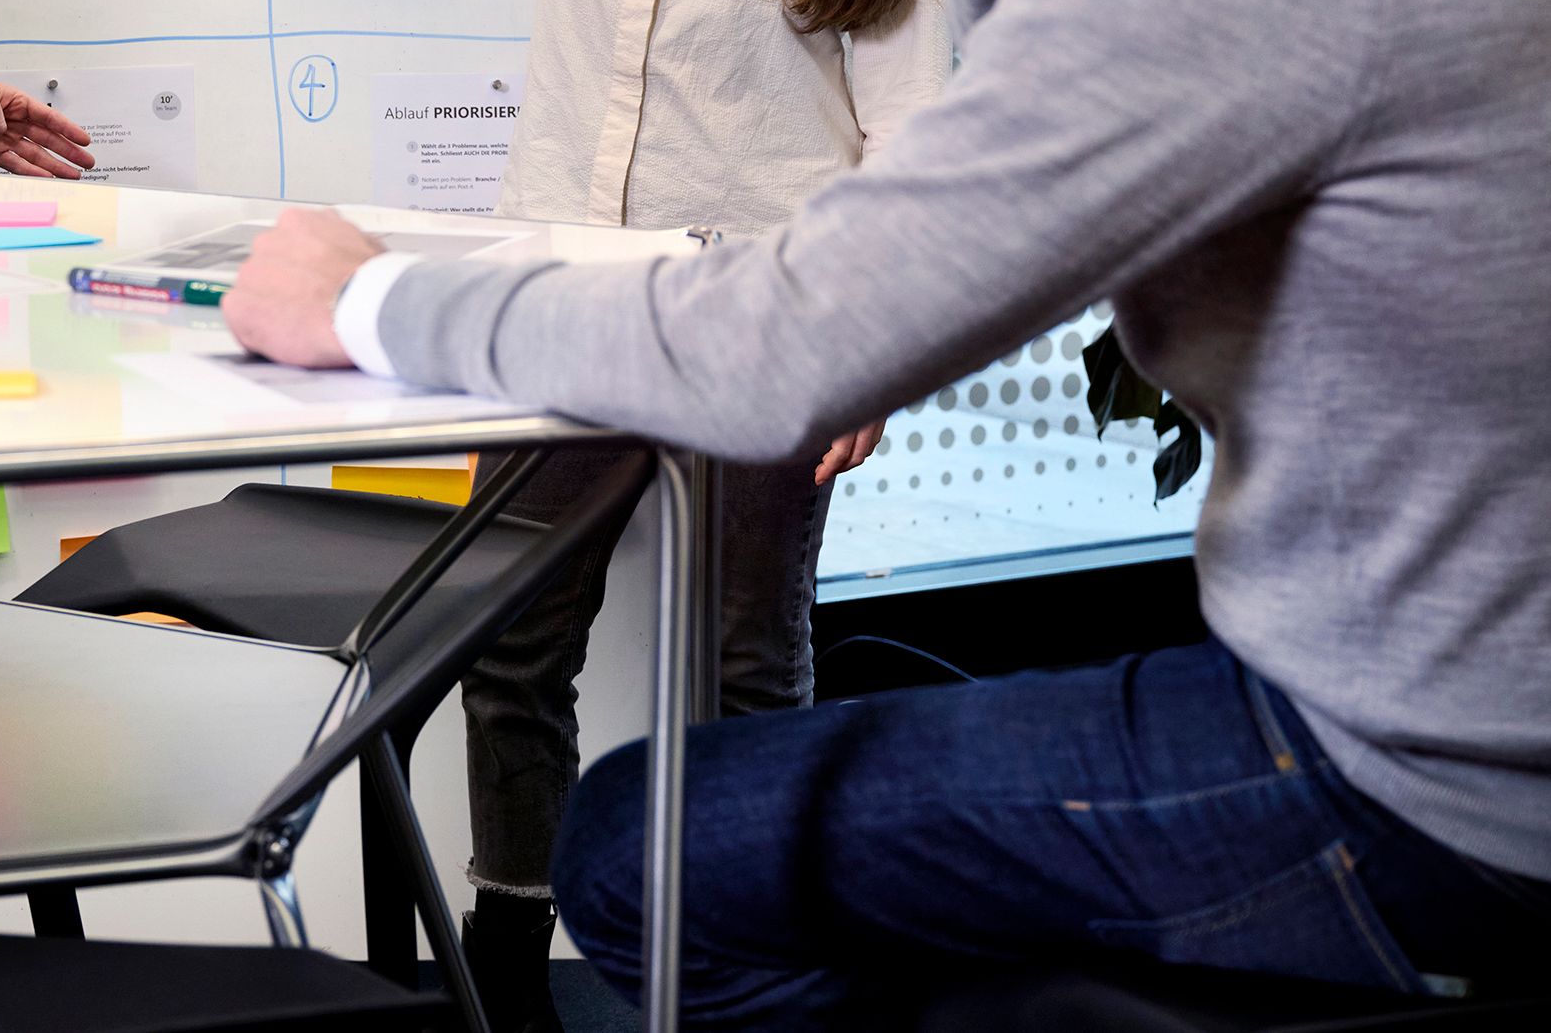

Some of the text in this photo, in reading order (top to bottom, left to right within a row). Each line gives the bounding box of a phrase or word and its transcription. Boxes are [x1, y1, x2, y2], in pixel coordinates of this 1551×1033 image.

[299, 63, 326, 117] 4
[384, 106, 521, 120] Ablauf PRIORISIER
[117, 164, 150, 173] befriedigen?
